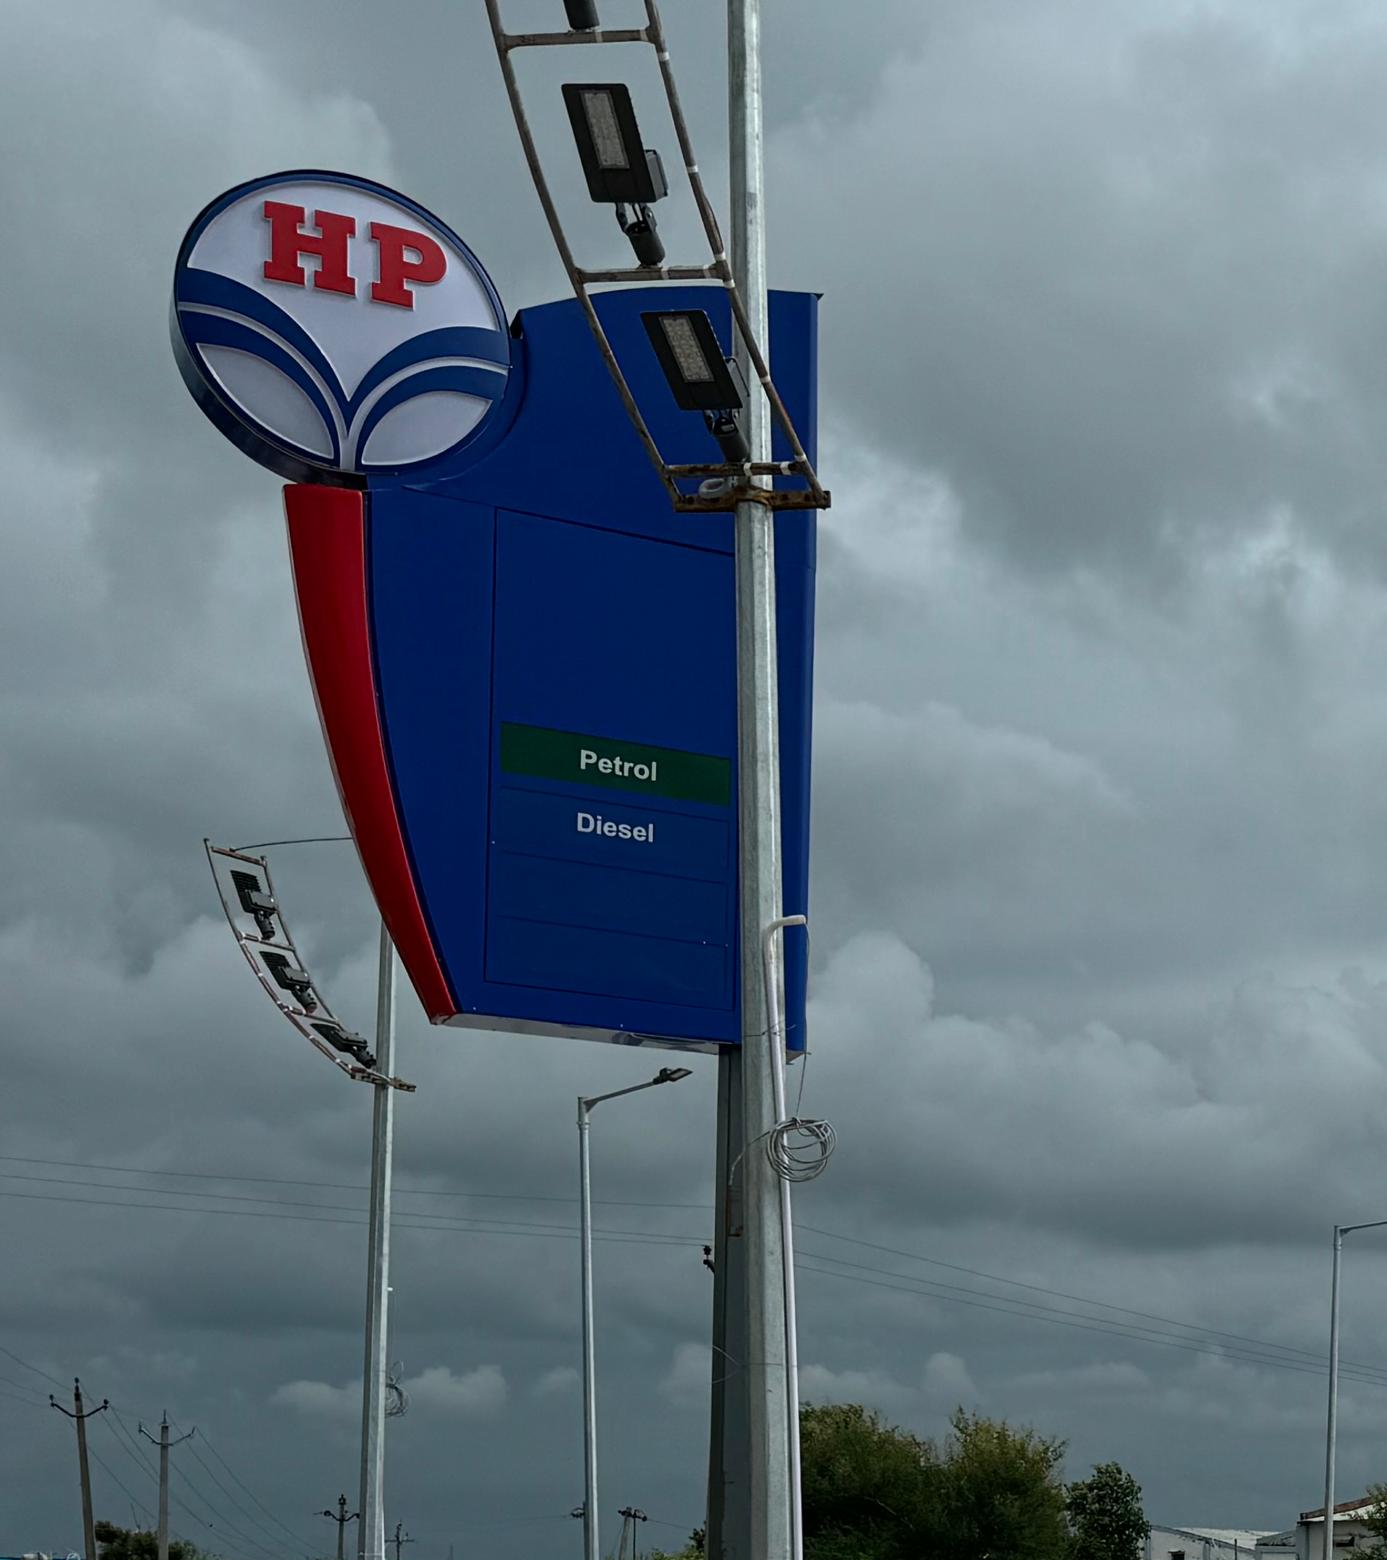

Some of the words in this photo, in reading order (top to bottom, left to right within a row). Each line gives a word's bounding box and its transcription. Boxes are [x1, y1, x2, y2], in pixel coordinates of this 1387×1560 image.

[264, 201, 447, 309] HP
[580, 749, 657, 781] Petrol
[577, 812, 654, 843] Diesel
